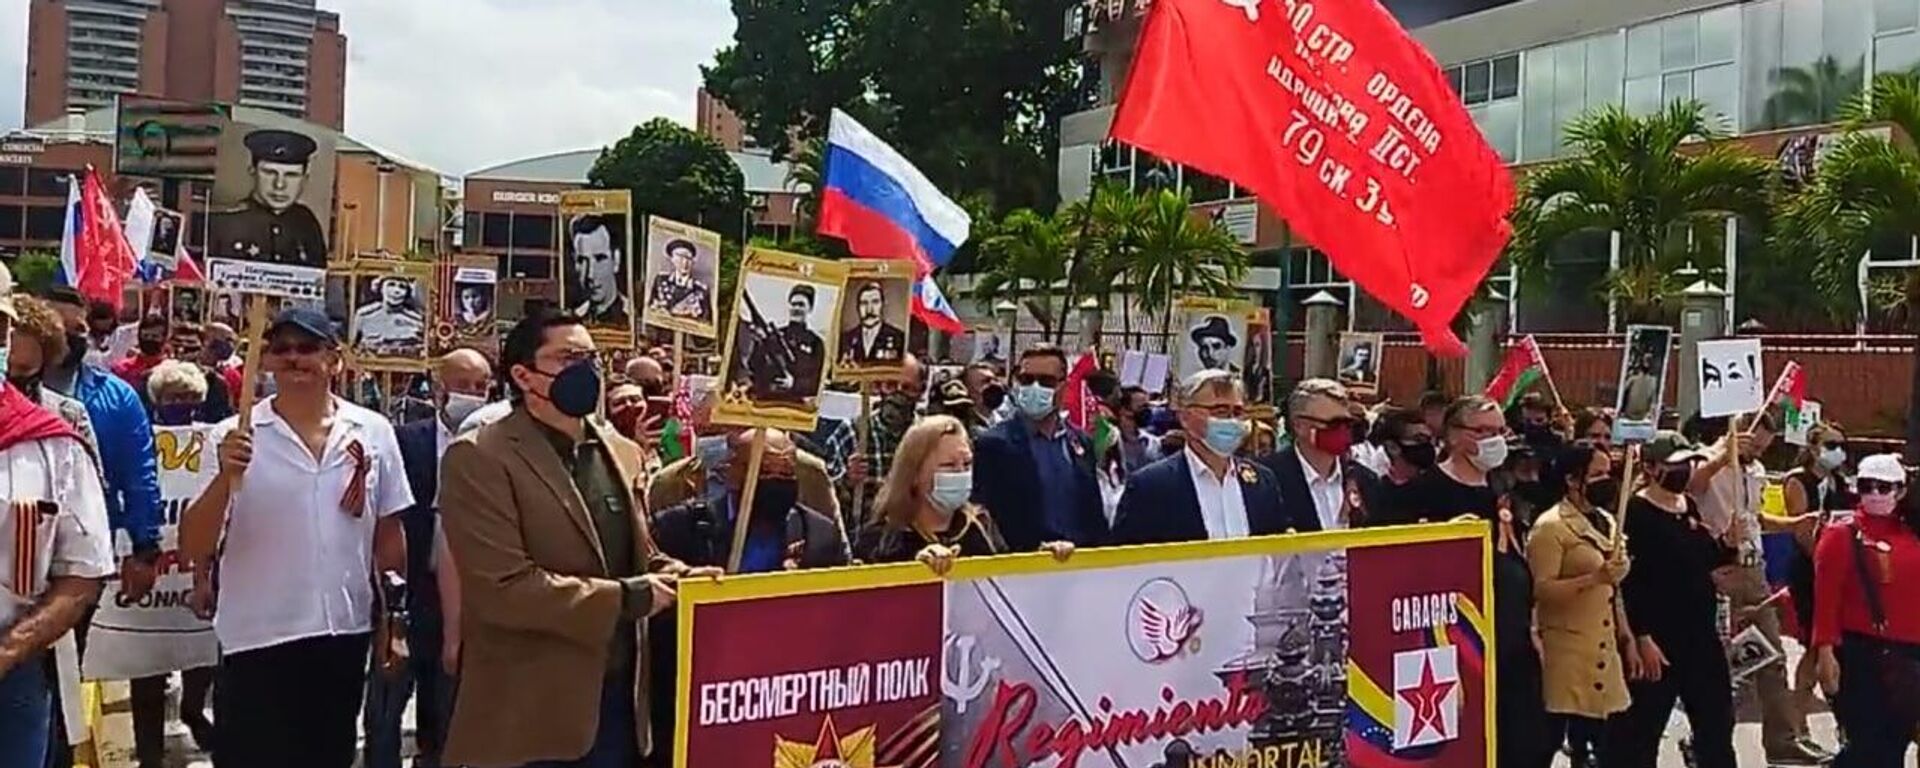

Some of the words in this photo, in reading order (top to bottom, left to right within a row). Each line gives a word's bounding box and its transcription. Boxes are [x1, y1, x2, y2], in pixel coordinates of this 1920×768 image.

[1283, 109, 1325, 166] 79
[1366, 72, 1442, 155] ОРДЕНА
[492, 191, 536, 203] BURGER
[1391, 591, 1459, 633] CARACAS
[700, 661, 872, 726] БЕССМЕРТНЫЙ
[876, 656, 931, 702] ПОЛК
[964, 674, 1270, 768] Regimiento
